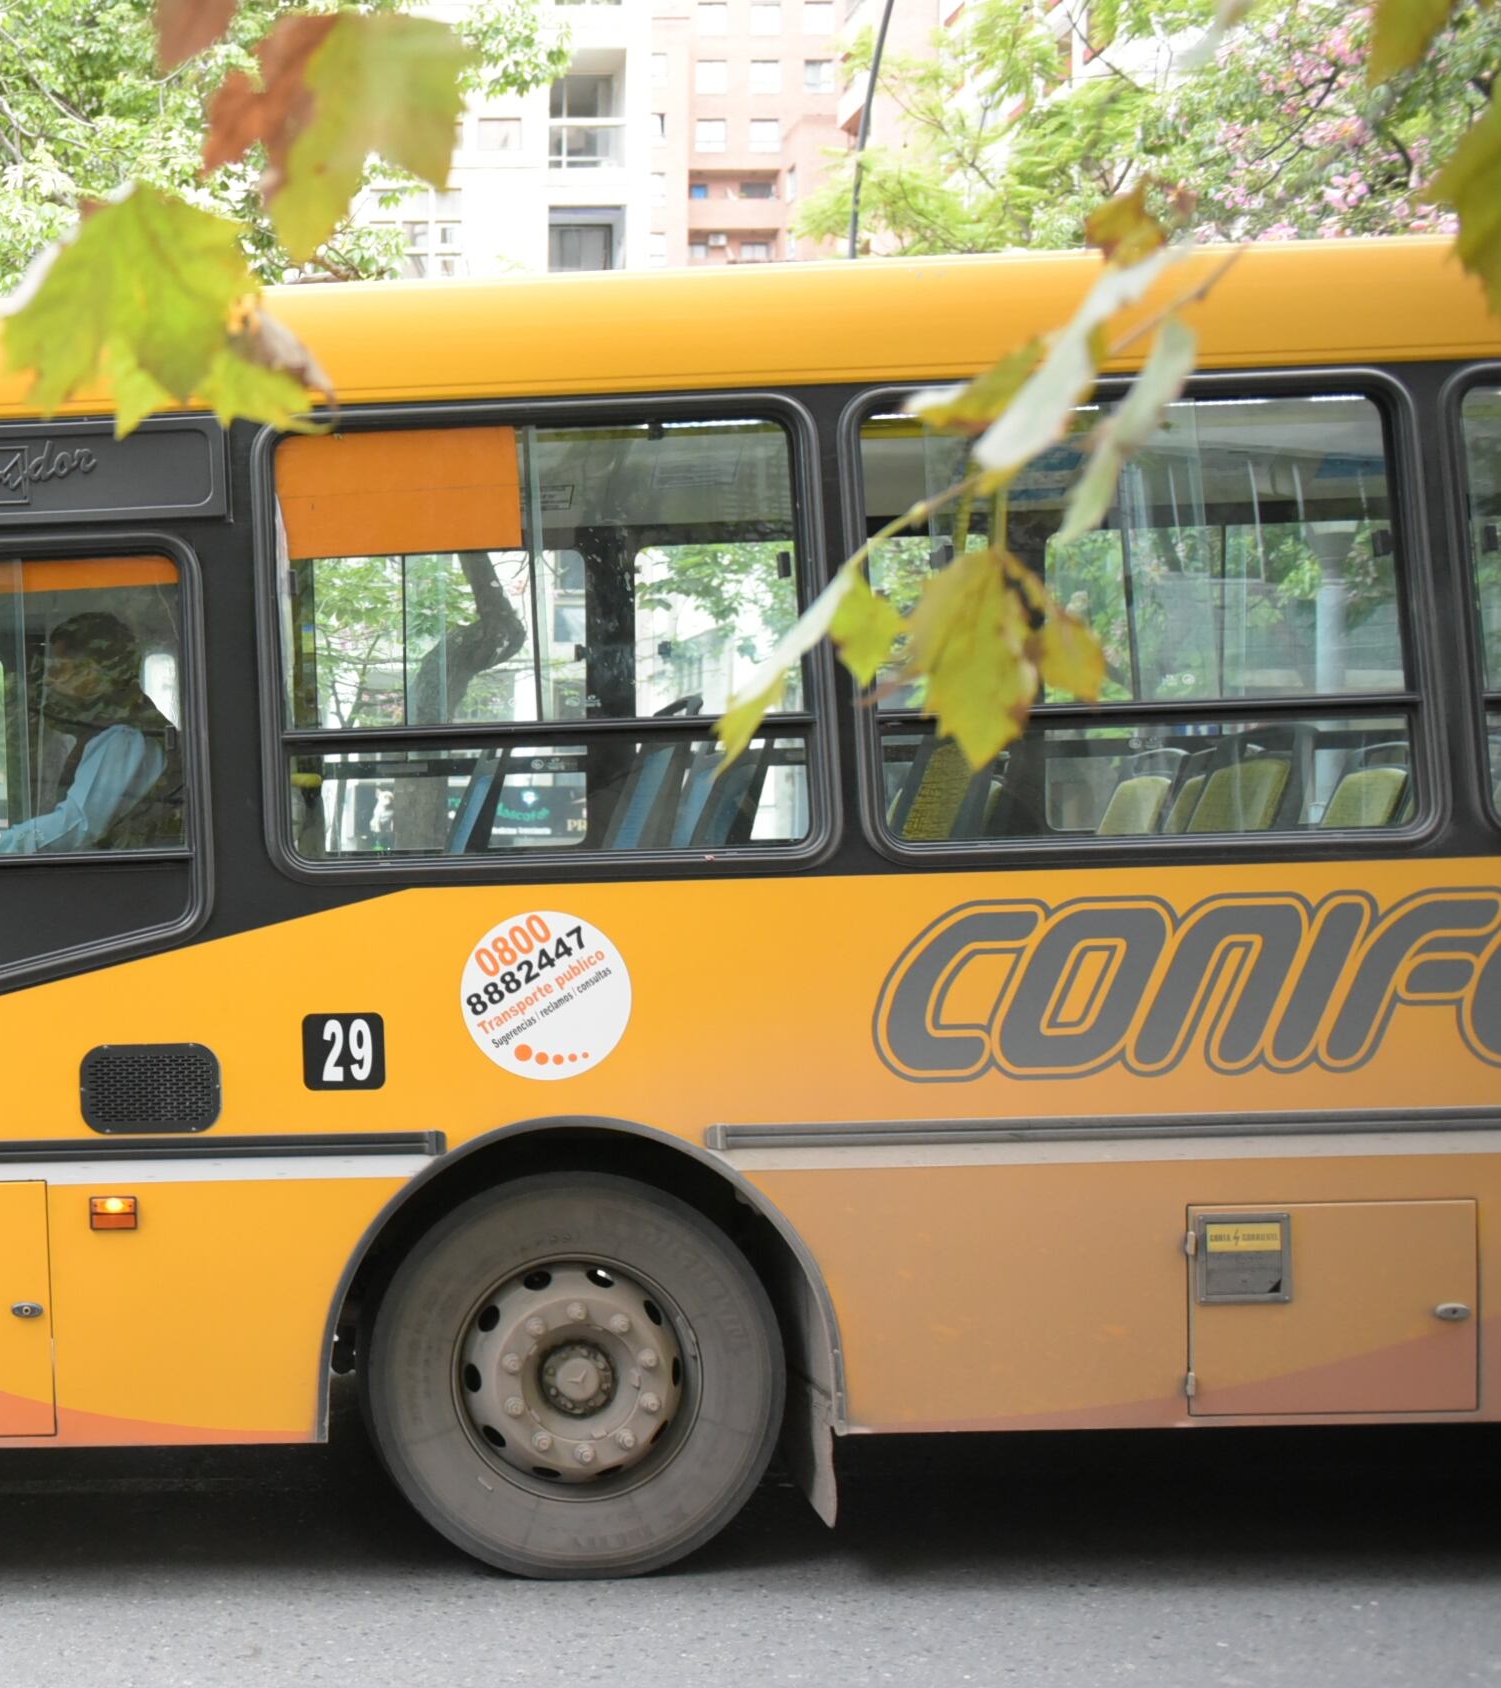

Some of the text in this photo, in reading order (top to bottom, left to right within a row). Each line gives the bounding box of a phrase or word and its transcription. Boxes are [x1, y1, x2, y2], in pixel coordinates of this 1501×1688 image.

[466, 925, 586, 1016] 8882447
[475, 914, 552, 977] 0800
[871, 886, 1501, 1083] CONIF
[477, 949, 606, 1035] Transporte publico
[491, 1015, 537, 1049] Sugerencias
[540, 992, 574, 1018] reclamos
[576, 967, 612, 994] consultas
[322, 1018, 373, 1081] 29
